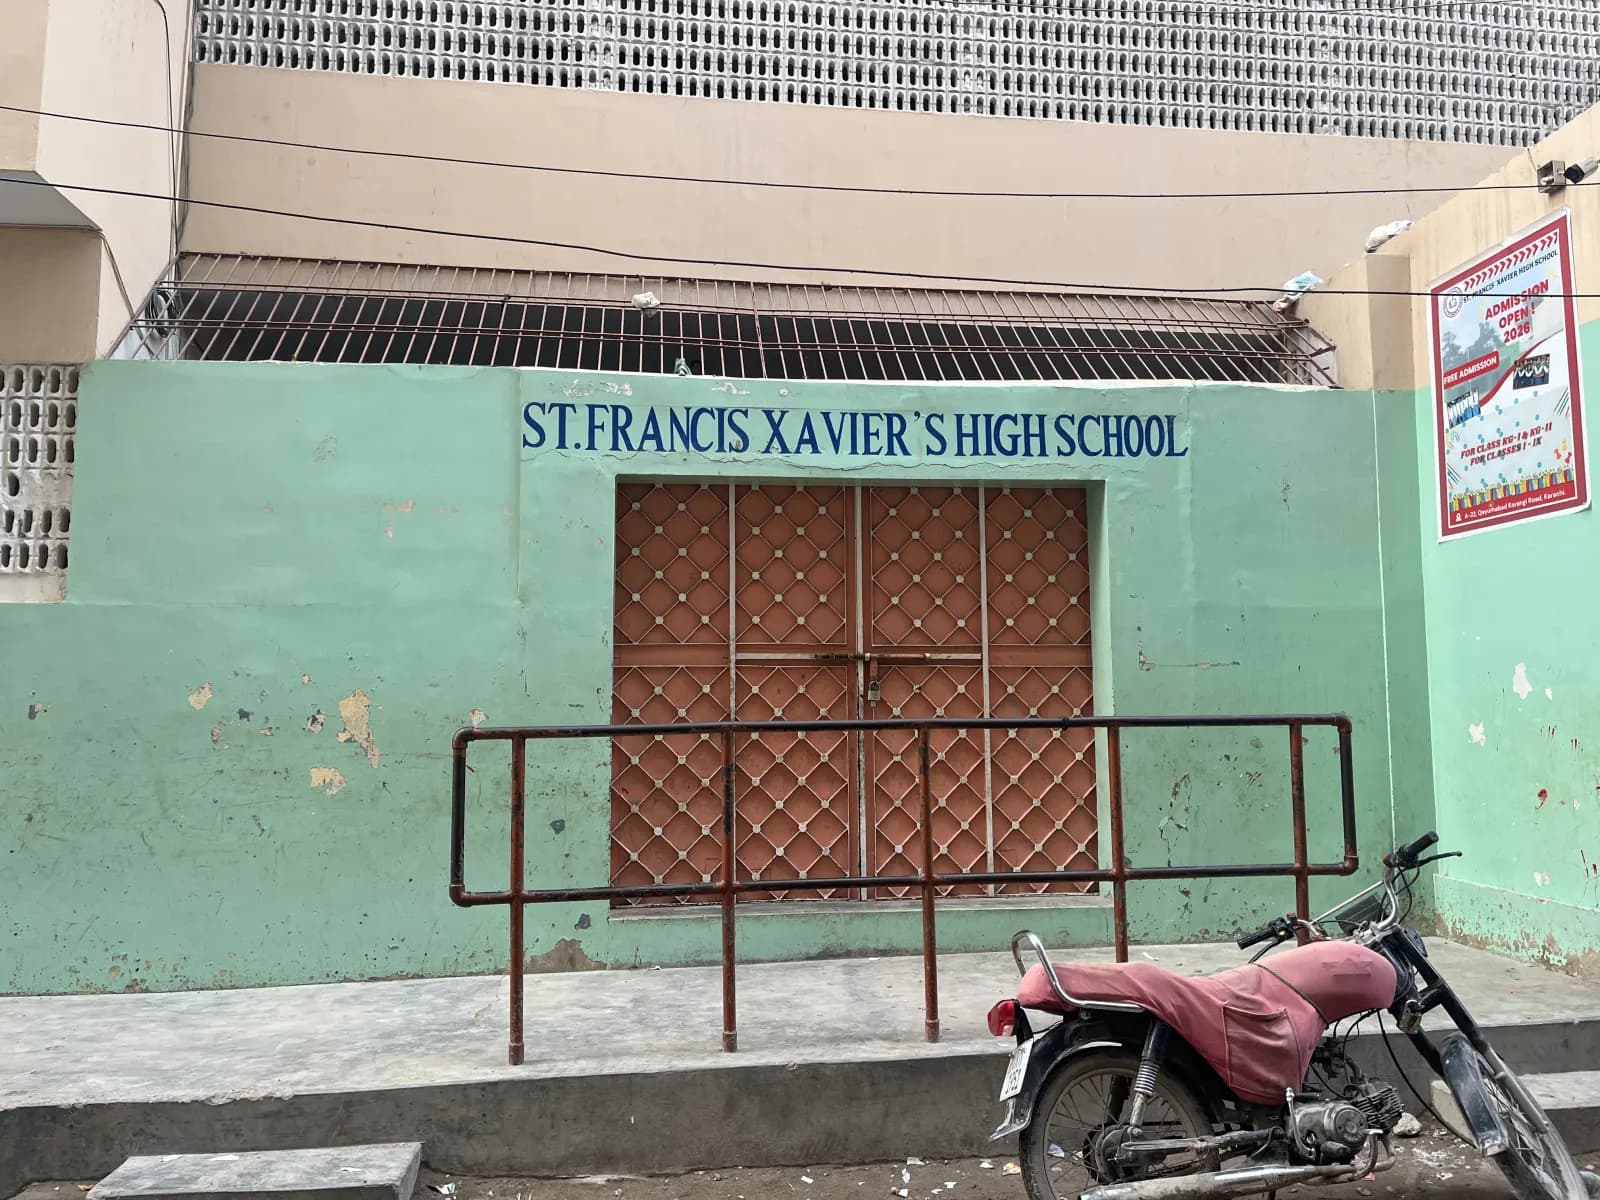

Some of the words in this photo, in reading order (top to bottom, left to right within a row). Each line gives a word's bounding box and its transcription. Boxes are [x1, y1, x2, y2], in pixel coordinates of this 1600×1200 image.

[1496, 270, 1518, 287] XAVIER
[1518, 262, 1534, 275] HIGH
[1535, 249, 1558, 267] SCHOOL
[1485, 279, 1549, 320] ADMISSION
[1499, 307, 1529, 329] OPEN
[1503, 321, 1530, 344] 2026
[1443, 373, 1459, 385] FREE
[1459, 356, 1497, 379] ADMISSION
[761, 409, 948, 457] XAVIER'S
[954, 413, 1049, 457] HIGH
[1053, 414, 1189, 457] SCHOOL
[1460, 447, 1476, 459] FOR
[1476, 439, 1501, 454] CLASS
[1521, 431, 1529, 441] &
[1470, 455, 1486, 467] FOR
[1486, 443, 1522, 461] CLASSES
[1533, 436, 1543, 447] IX
[1507, 498, 1529, 510] Korangi
